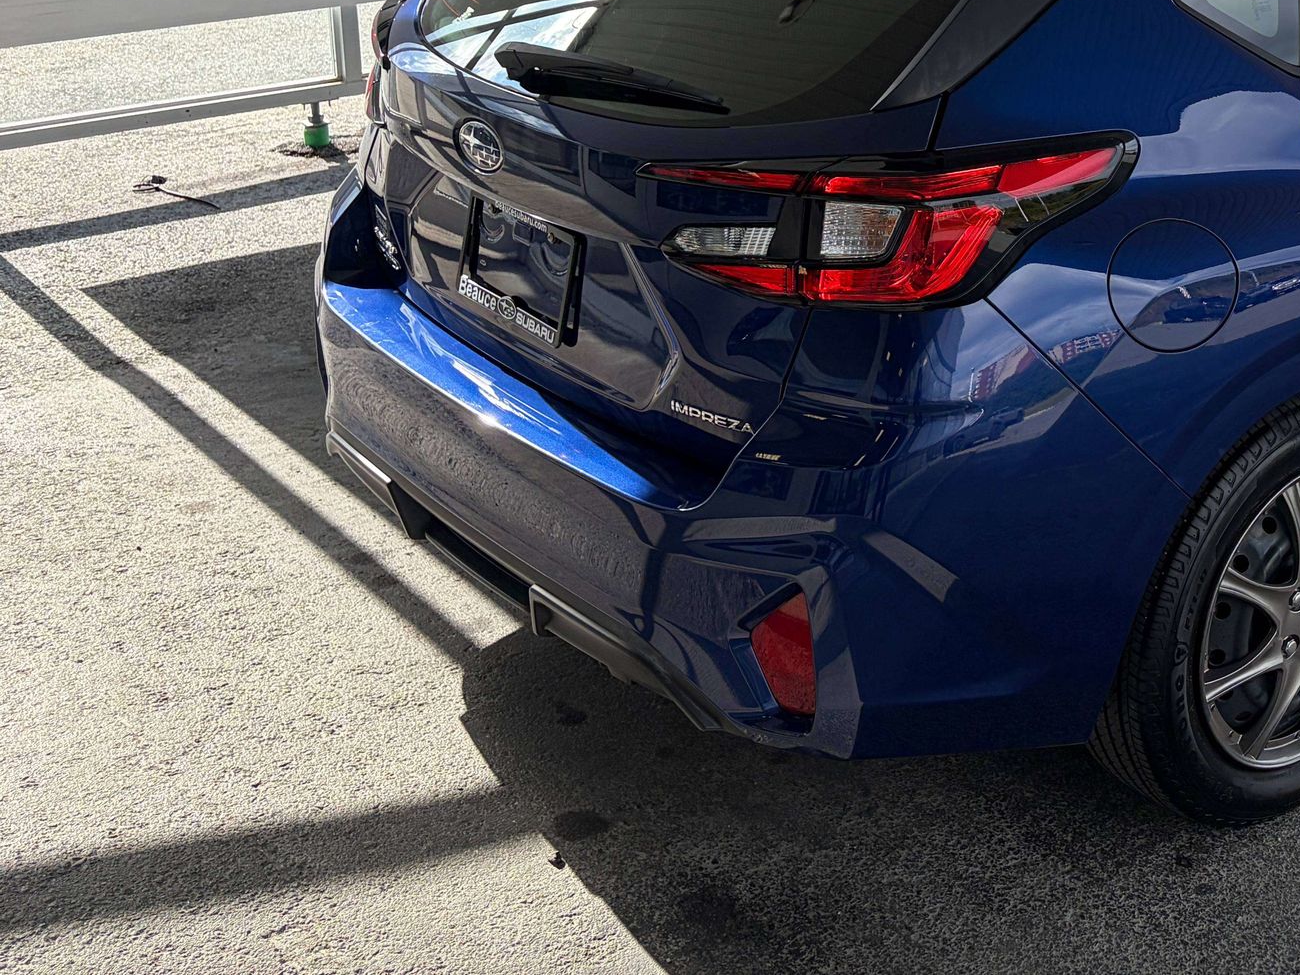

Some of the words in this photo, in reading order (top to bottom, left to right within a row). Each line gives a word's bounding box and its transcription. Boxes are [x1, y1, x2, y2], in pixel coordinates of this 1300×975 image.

[458, 274, 497, 311] Beauce
[515, 312, 555, 344] SUBARU
[670, 399, 755, 436] IMPREZA
